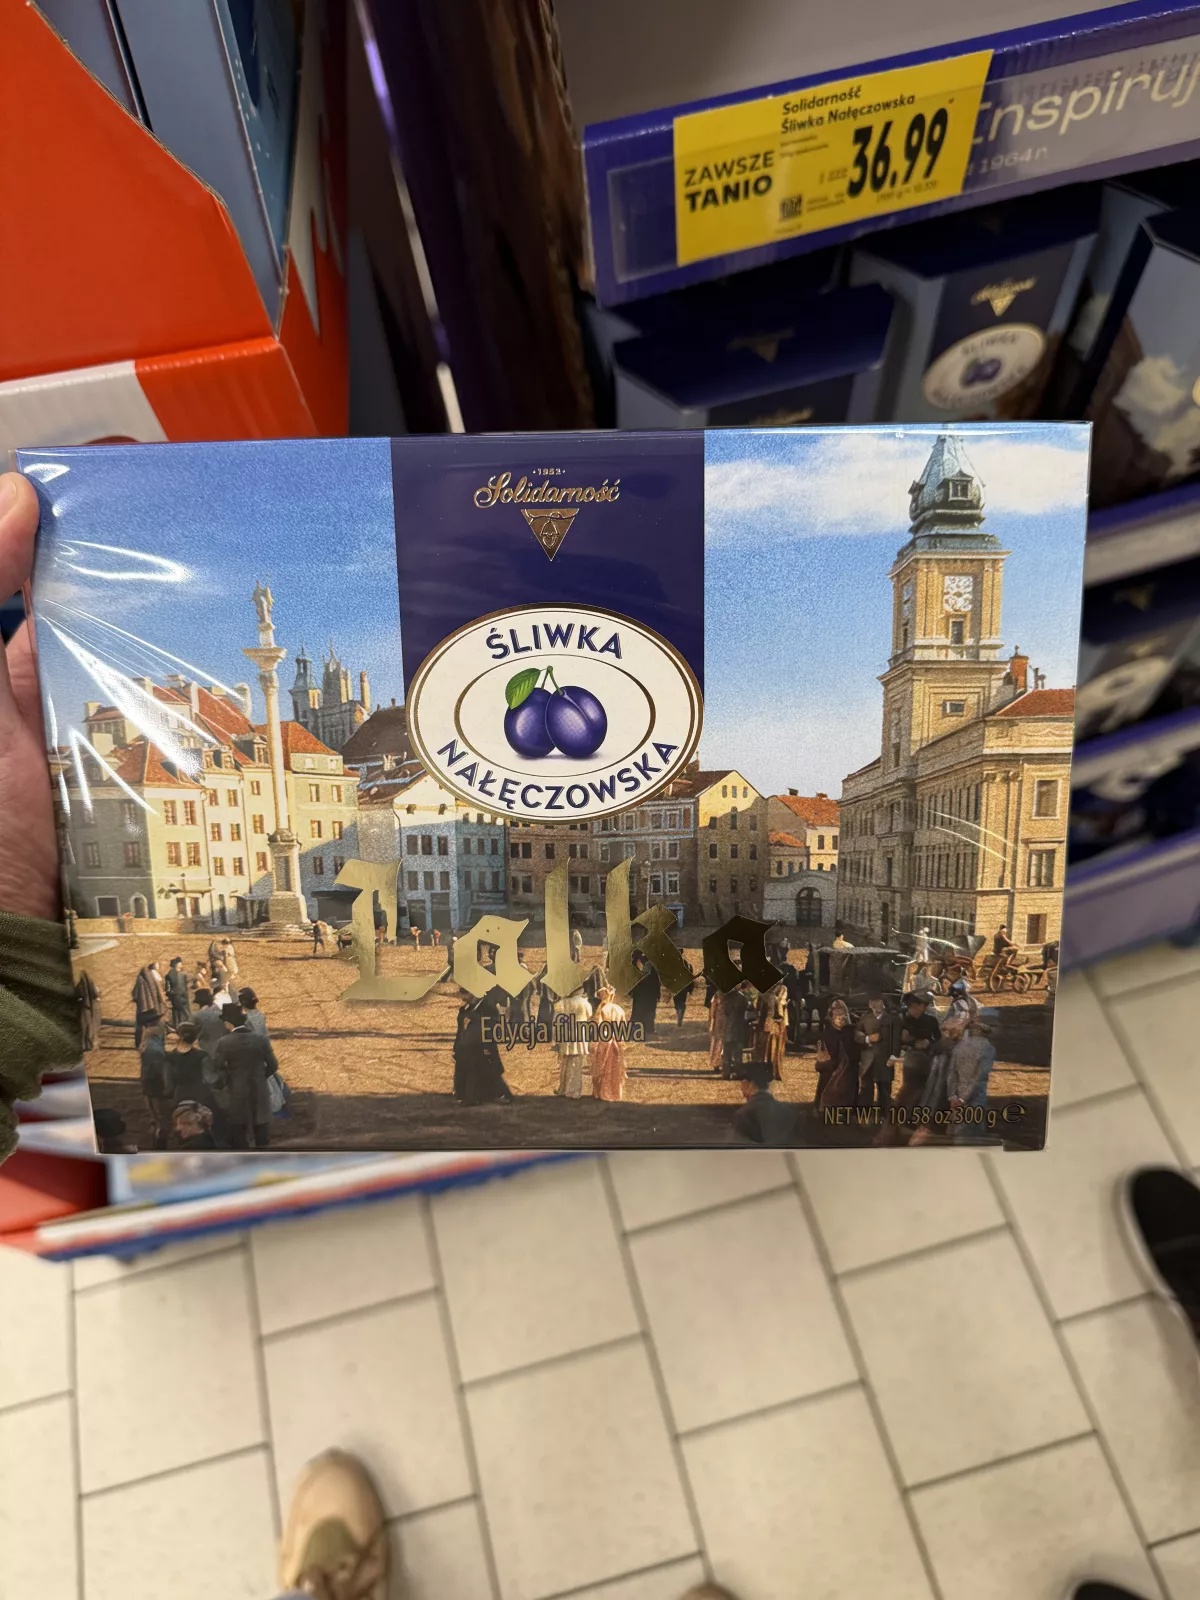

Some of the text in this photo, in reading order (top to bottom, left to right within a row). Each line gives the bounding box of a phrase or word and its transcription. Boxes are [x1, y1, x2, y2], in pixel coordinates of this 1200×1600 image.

[780, 94, 916, 135] Śliwka Nałęczowska
[781, 84, 862, 116] Solidarność
[684, 149, 776, 188] ZAWSZE
[846, 106, 949, 199] 36.99
[685, 174, 774, 213] TANIO
[473, 471, 621, 509] Solidarność
[485, 622, 623, 660] ŚLIWKA
[436, 738, 681, 811] NAŁĘCZOWSKA
[332, 854, 789, 1001] Lalka
[479, 1012, 647, 1051] Edycja filmowa
[823, 1106, 853, 1125] NET
[855, 1106, 883, 1125] WT.
[889, 1106, 931, 1125] 10.58
[934, 1111, 951, 1125] oz
[954, 1106, 984, 1125] 300
[986, 1110, 997, 1129] g
